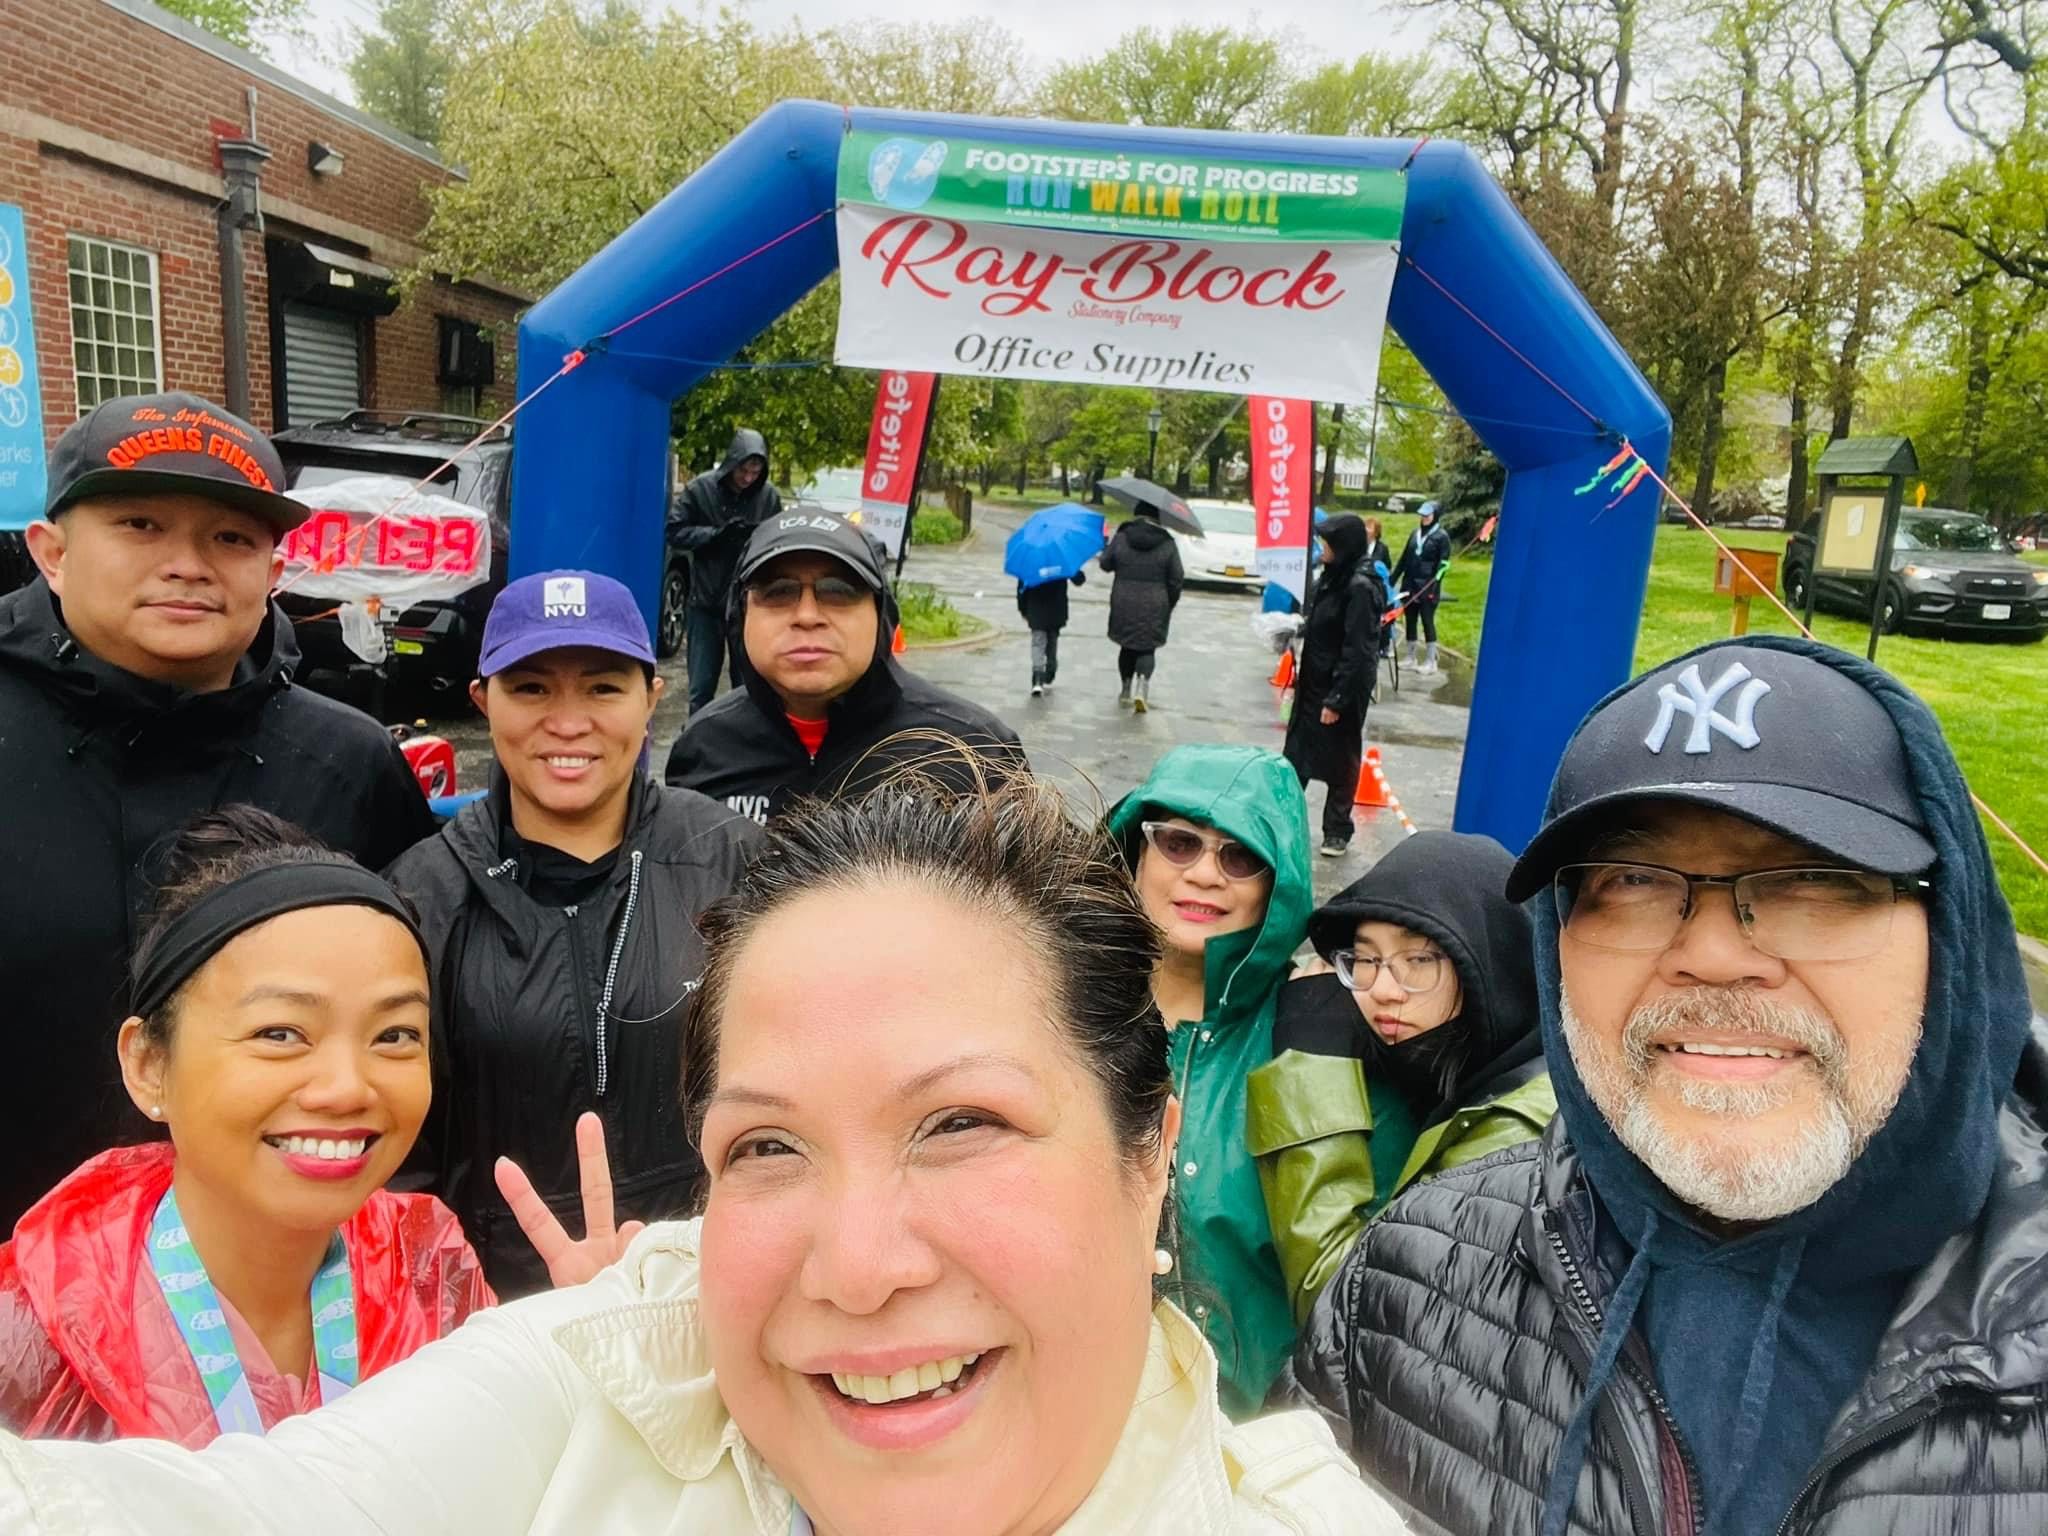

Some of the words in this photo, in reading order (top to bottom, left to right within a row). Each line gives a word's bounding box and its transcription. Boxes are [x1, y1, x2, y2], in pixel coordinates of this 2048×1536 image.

[965, 148, 1132, 180] FOOTSTEPS
[1138, 163, 1199, 187] FOR
[1204, 167, 1359, 196] PROGRESS
[1006, 175, 1072, 209] RUN
[1089, 181, 1183, 218] WALK
[1202, 189, 1280, 224] ROLL
[861, 214, 1345, 317] Ray-Block
[1129, 304, 1183, 329] Company
[953, 333, 1075, 373] Office
[1085, 343, 1255, 384] Supplies
[132, 408, 166, 421] The
[107, 427, 203, 469] QUEENS
[544, 605, 587, 618] NYU
[1644, 662, 1772, 755] NY
